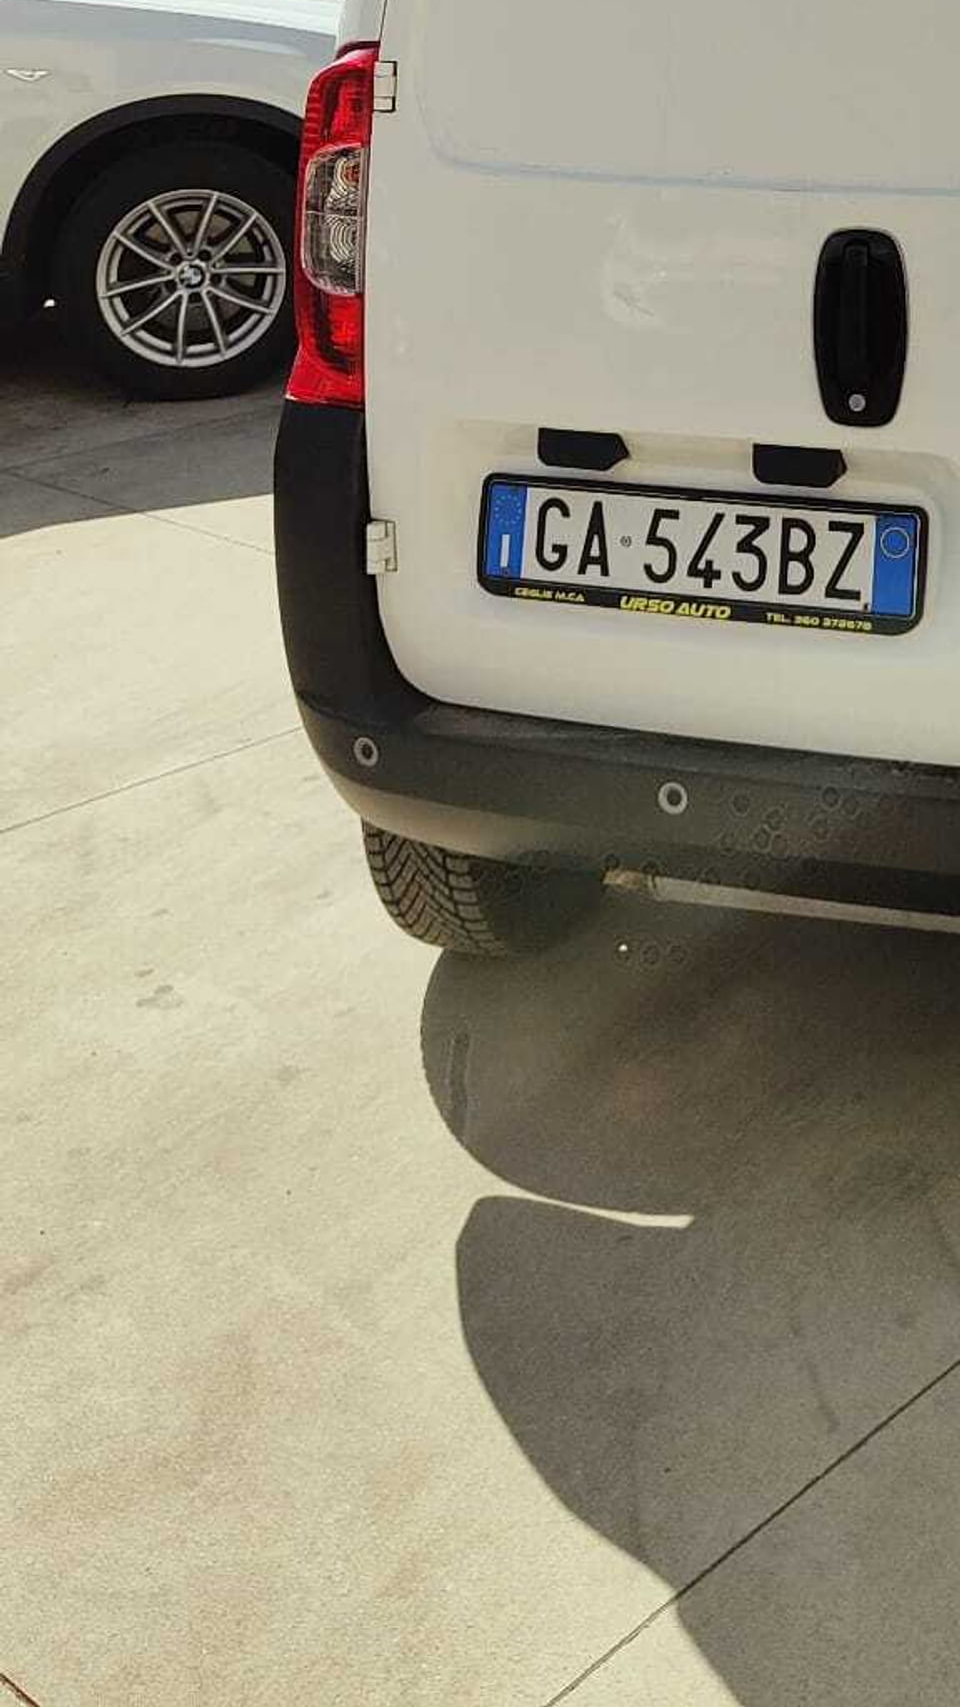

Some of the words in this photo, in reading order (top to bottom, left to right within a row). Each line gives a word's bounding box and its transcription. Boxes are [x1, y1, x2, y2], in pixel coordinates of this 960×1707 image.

[535, 497, 610, 577] GA
[643, 508, 866, 601] 543BZ
[619, 595, 674, 613] URSO
[676, 602, 731, 619] AUTO
